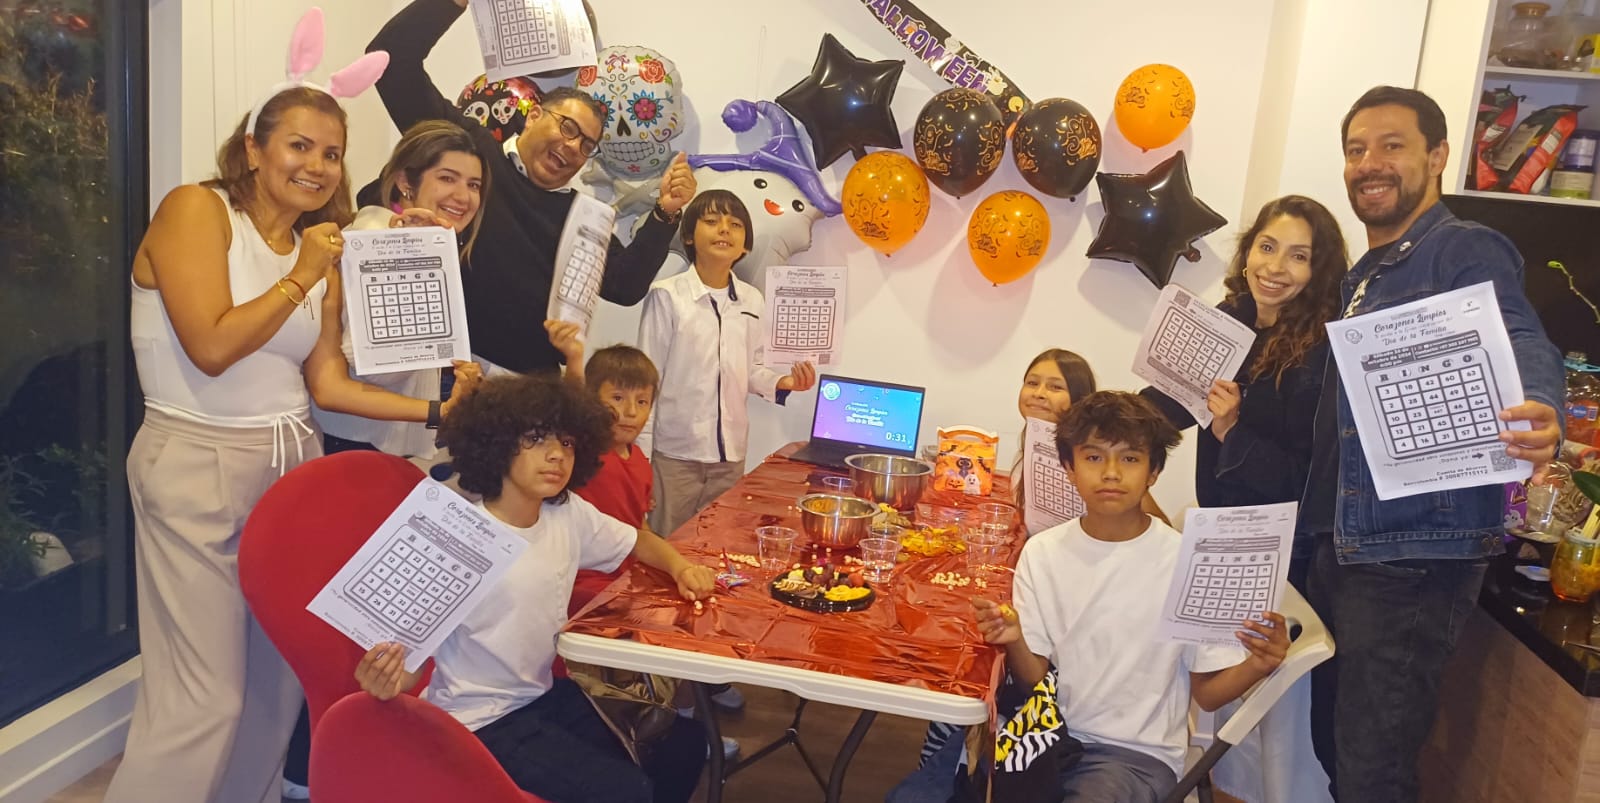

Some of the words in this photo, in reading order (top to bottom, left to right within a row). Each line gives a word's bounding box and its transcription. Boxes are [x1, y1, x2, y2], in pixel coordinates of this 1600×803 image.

[866, 0, 989, 93] ALLOWEEN
[1444, 374, 1455, 382] 60
[1466, 369, 1476, 377] 63
[1470, 384, 1481, 392] 65
[1474, 398, 1484, 406] 64
[1436, 419, 1447, 427] 45
[1457, 415, 1466, 423] 47
[1478, 411, 1488, 419] 62
[885, 431, 906, 443] 0:31
[1460, 428, 1470, 436] 57
[387, 555, 396, 564] 12
[381, 587, 392, 596] 30
[387, 608, 397, 617] 31
[401, 618, 411, 626] 47
